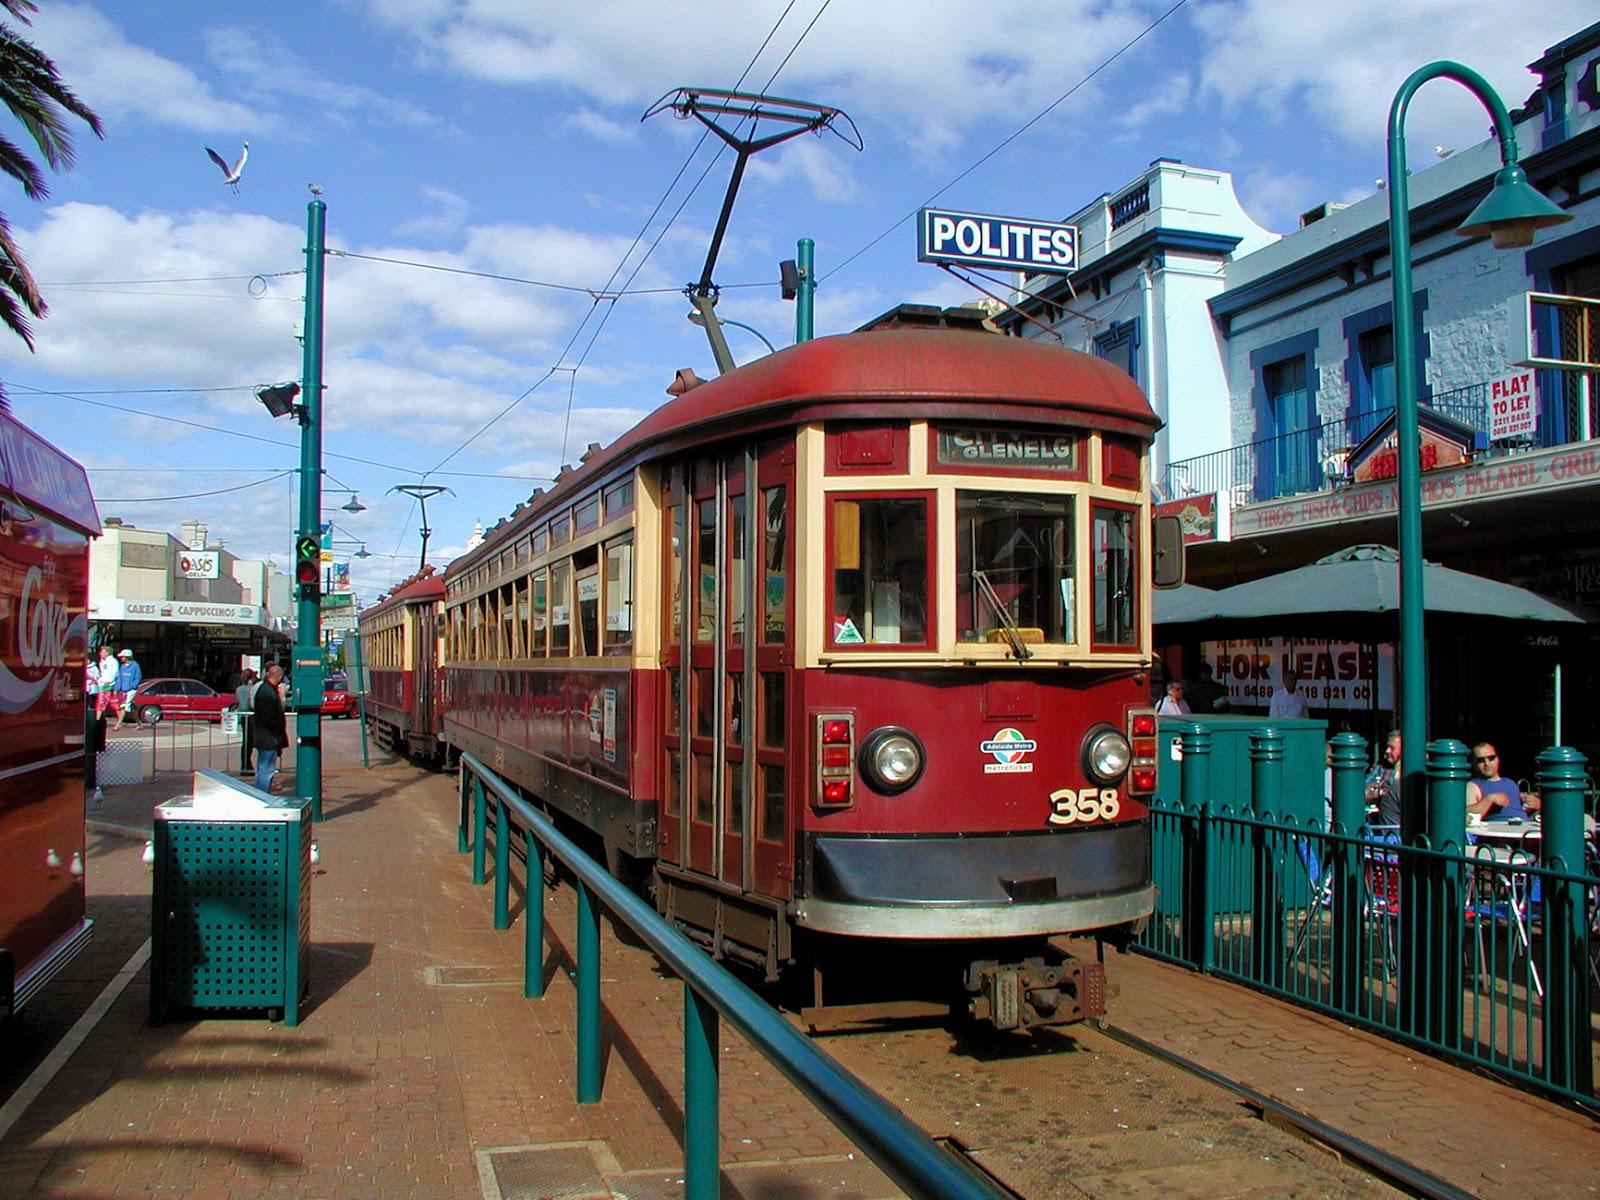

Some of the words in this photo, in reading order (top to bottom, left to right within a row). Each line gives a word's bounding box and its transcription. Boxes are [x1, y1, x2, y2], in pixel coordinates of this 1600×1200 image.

[934, 216, 1074, 265] POLITES
[1492, 374, 1529, 400] FLAT
[1493, 401, 1507, 415] TO
[1511, 395, 1530, 412] LET
[963, 438, 1070, 460] GLENELG
[1256, 506, 1294, 529] YIROS
[1301, 499, 1330, 521] FISH
[1343, 488, 1383, 514] CHIPS
[1465, 460, 1537, 496] FALAFEL
[181, 557, 213, 573] OASIS
[19, 565, 68, 668] Coke
[127, 603, 156, 614] CAKES
[178, 605, 236, 617] CAPPUCCINOS
[1216, 653, 1270, 681] FOR
[1282, 651, 1375, 681] LEASE
[1323, 686, 1346, 700] 821
[986, 742, 1014, 750] Adelaide
[1014, 742, 1032, 750] Metro
[986, 764, 1032, 772] metroticket
[1050, 787, 1120, 825] 358
